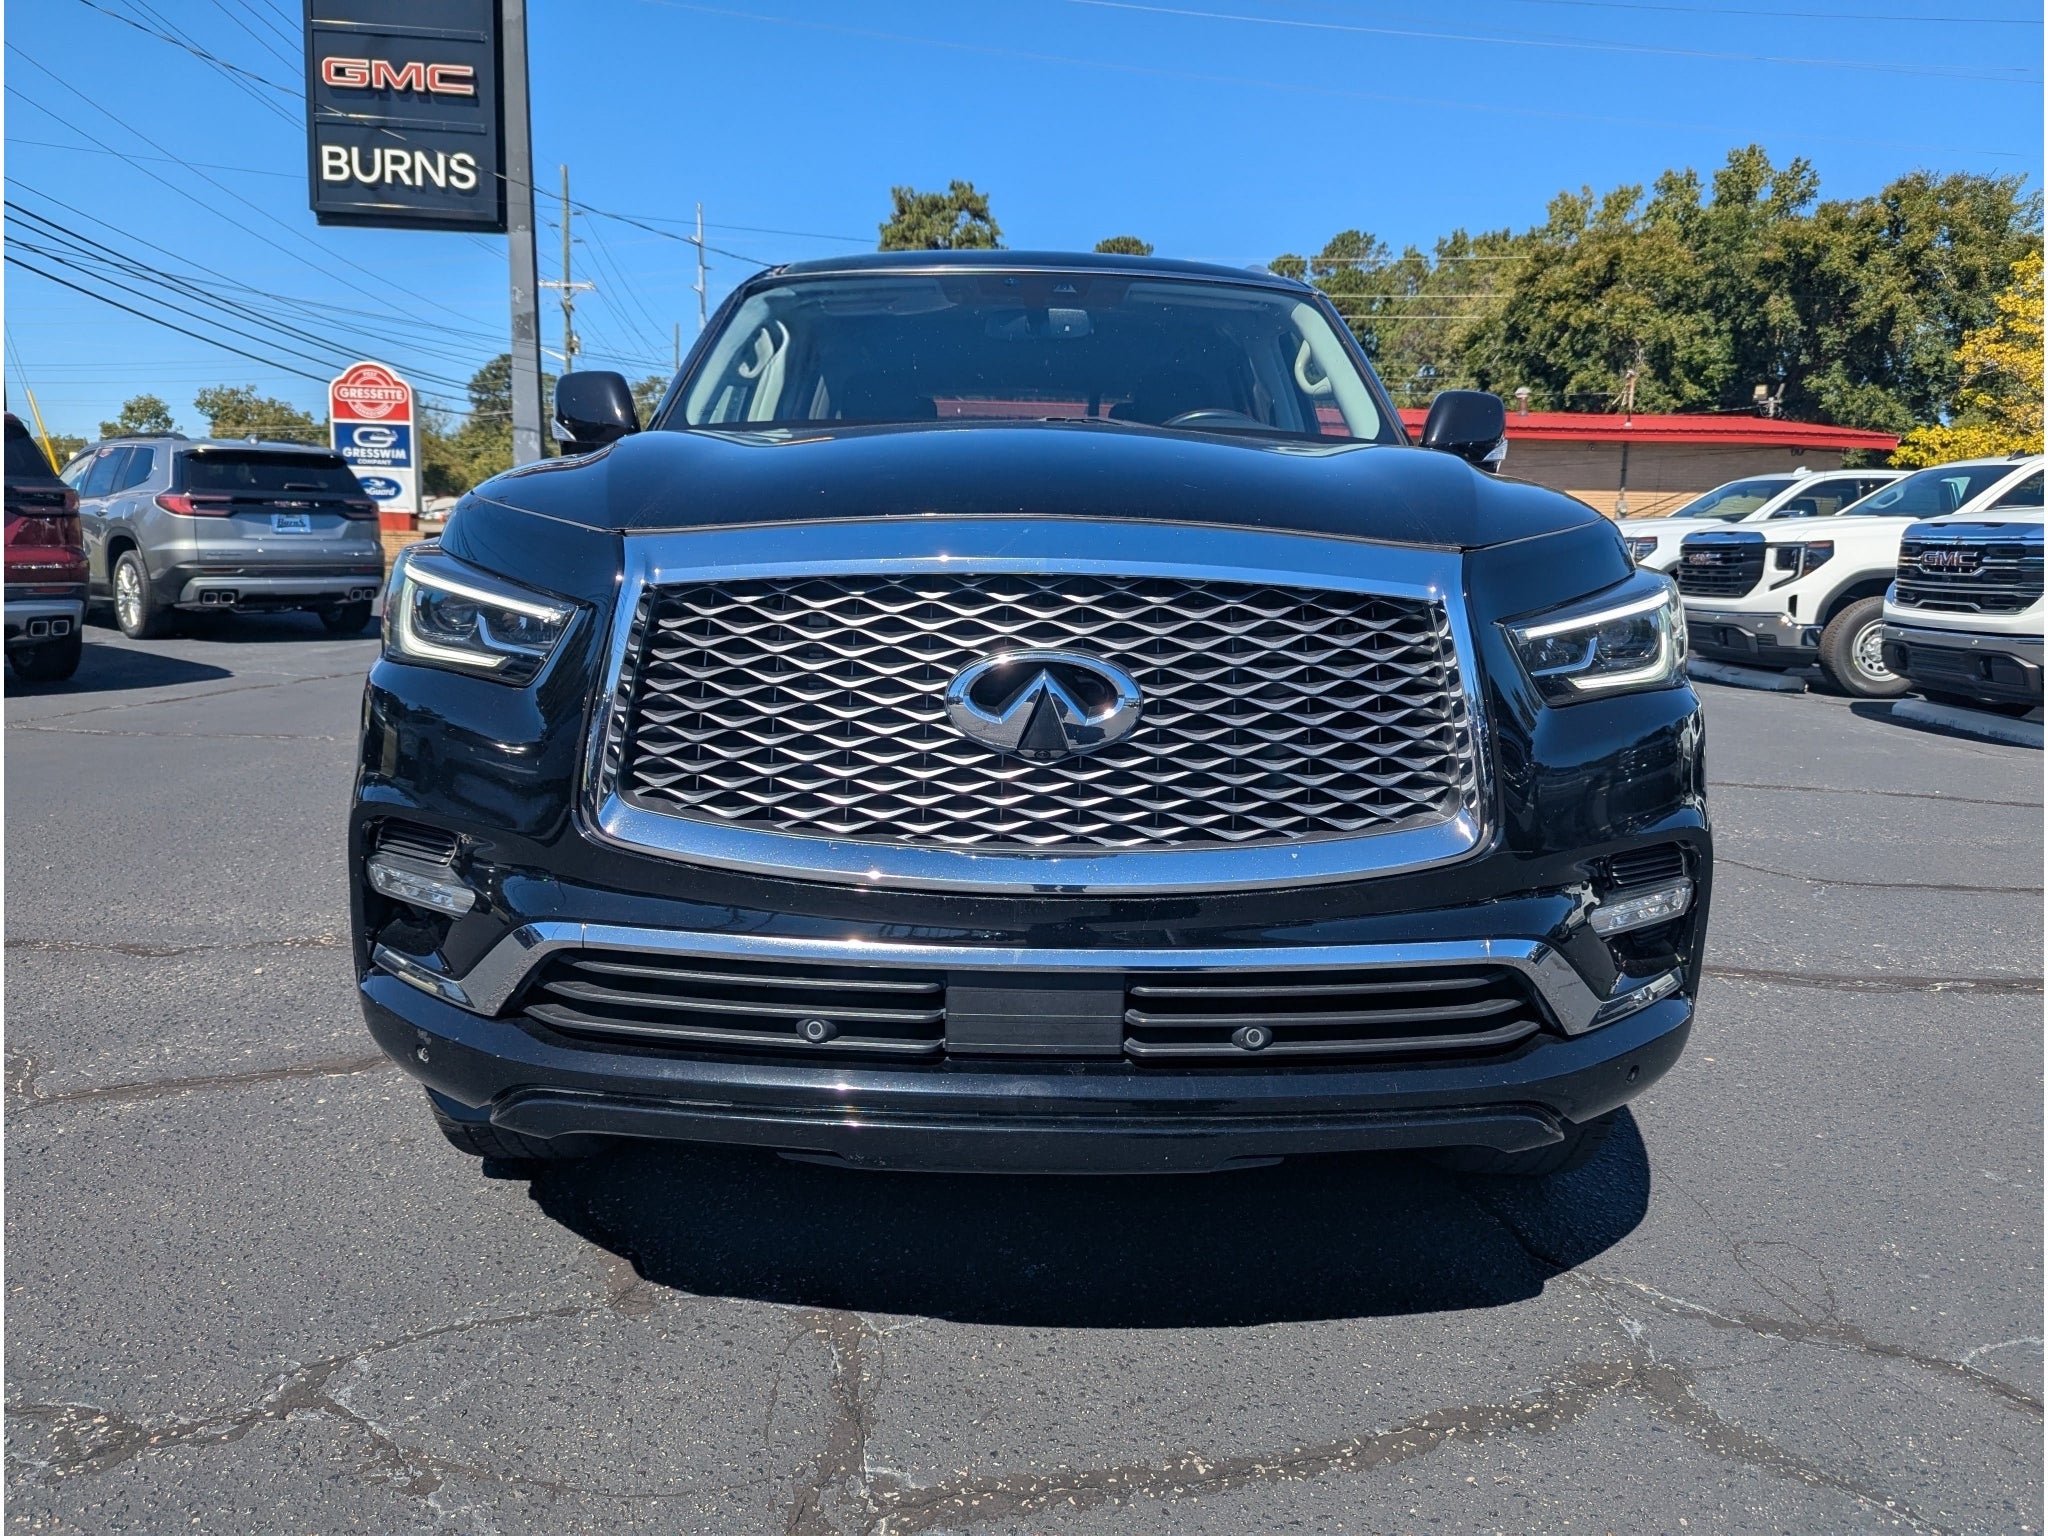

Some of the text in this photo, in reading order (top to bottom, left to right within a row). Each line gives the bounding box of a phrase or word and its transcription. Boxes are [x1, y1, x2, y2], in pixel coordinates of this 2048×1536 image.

[322, 57, 475, 96] GMC
[321, 144, 477, 190] BURNS
[339, 387, 403, 400] GRESSETTE
[342, 447, 407, 459] GRESSWIM
[1921, 550, 1978, 567] GMC
